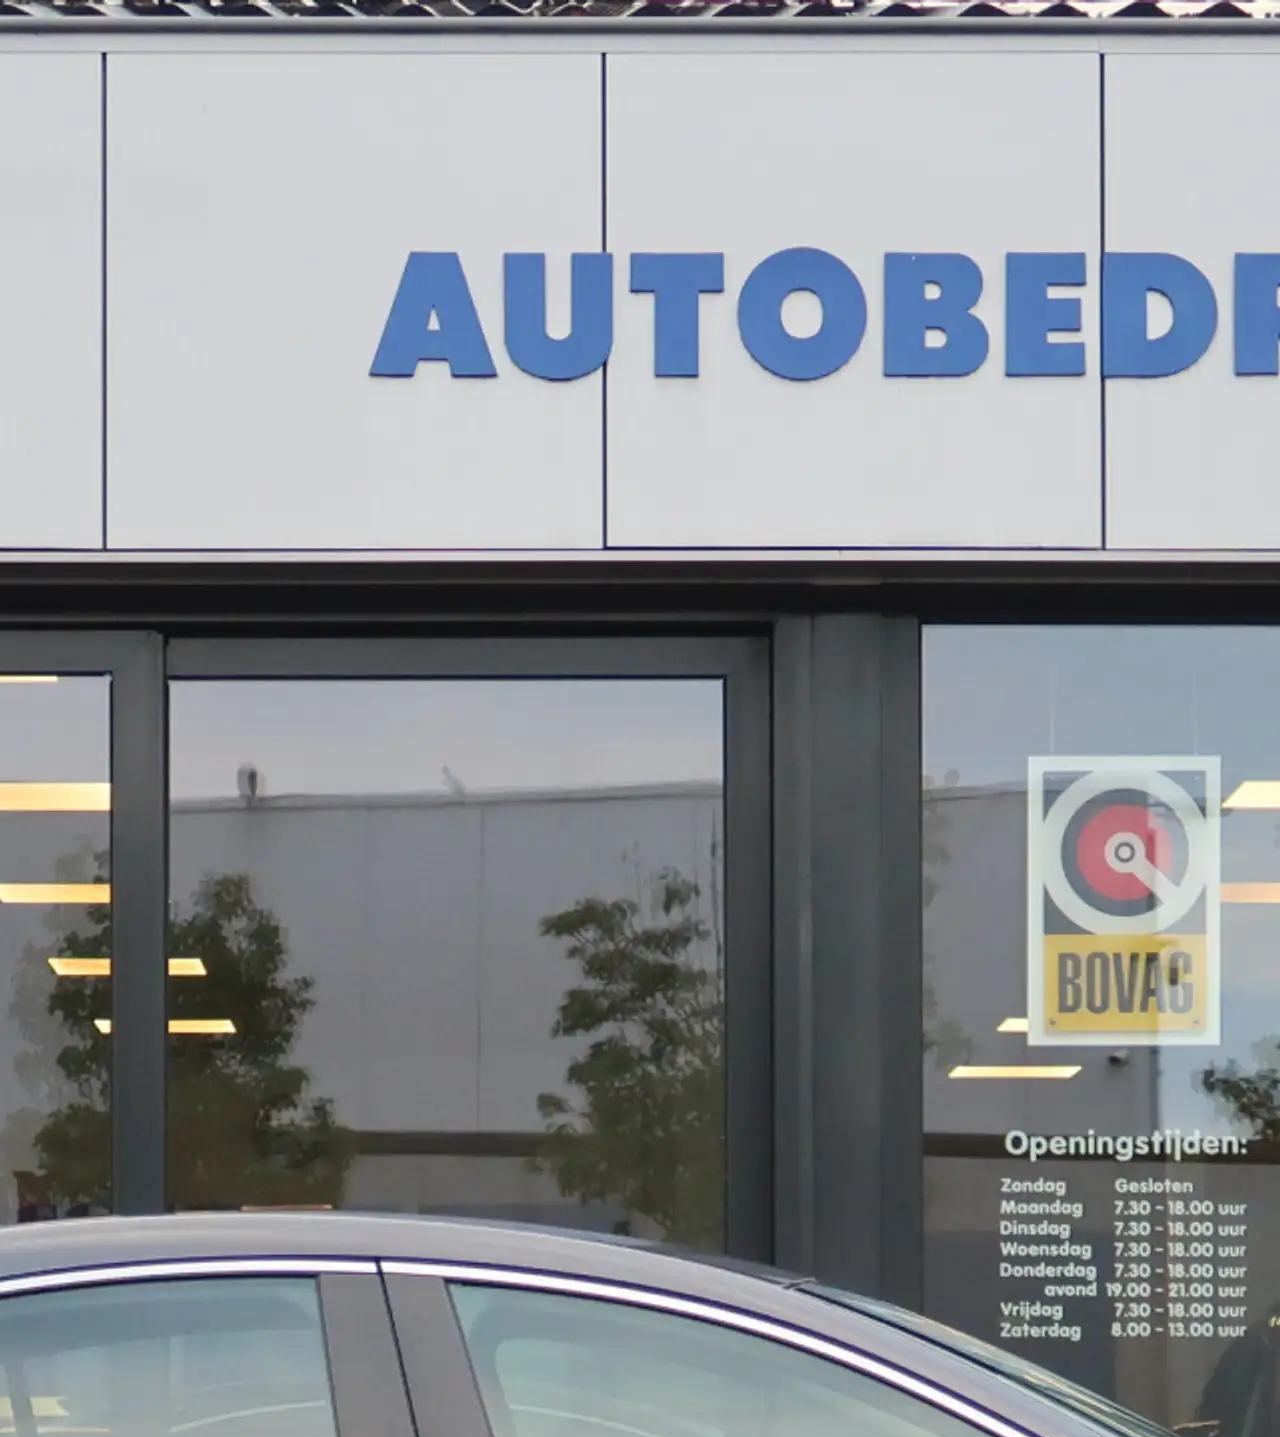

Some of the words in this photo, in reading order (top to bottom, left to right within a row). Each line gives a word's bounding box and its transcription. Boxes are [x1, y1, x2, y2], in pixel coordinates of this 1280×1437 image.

[1057, 951, 1194, 1014] BOVAG
[1005, 1129, 1248, 1162] Openingstijden:
[1001, 1178, 1066, 1196] Zondag
[1115, 1178, 1193, 1193] Gesloten
[1000, 1200, 1083, 1219] Maandag
[1114, 1201, 1151, 1215] 7.30
[1168, 1201, 1213, 1215] 18.00
[1219, 1204, 1247, 1215] uur
[1000, 1221, 1070, 1239] Dinsdag
[1114, 1222, 1151, 1236] 7.30
[1168, 1222, 1213, 1236] 18.00
[1219, 1225, 1247, 1236] uur
[1000, 1242, 1092, 1260] Woensdag
[1114, 1243, 1151, 1257] 7.30
[1168, 1243, 1213, 1257] 18.00
[1219, 1245, 1247, 1257] uur
[1000, 1263, 1097, 1280] Donderdag
[1114, 1264, 1151, 1278] 7.30
[1168, 1264, 1213, 1278] 18.00
[1219, 1266, 1247, 1278] uur
[1044, 1283, 1097, 1297] avond
[1105, 1283, 1151, 1297] 19.00
[1168, 1283, 1213, 1297] 21.00
[1219, 1286, 1247, 1298] uur
[1001, 1302, 1063, 1320] Vrijdag
[1114, 1303, 1151, 1317] 7.30
[1168, 1303, 1213, 1317] 18.00
[1219, 1306, 1247, 1317] uur
[1000, 1323, 1081, 1341] Zaterdag
[1111, 1323, 1151, 1337] 8.00
[1168, 1323, 1213, 1337] 13.00
[1219, 1326, 1247, 1338] uur
